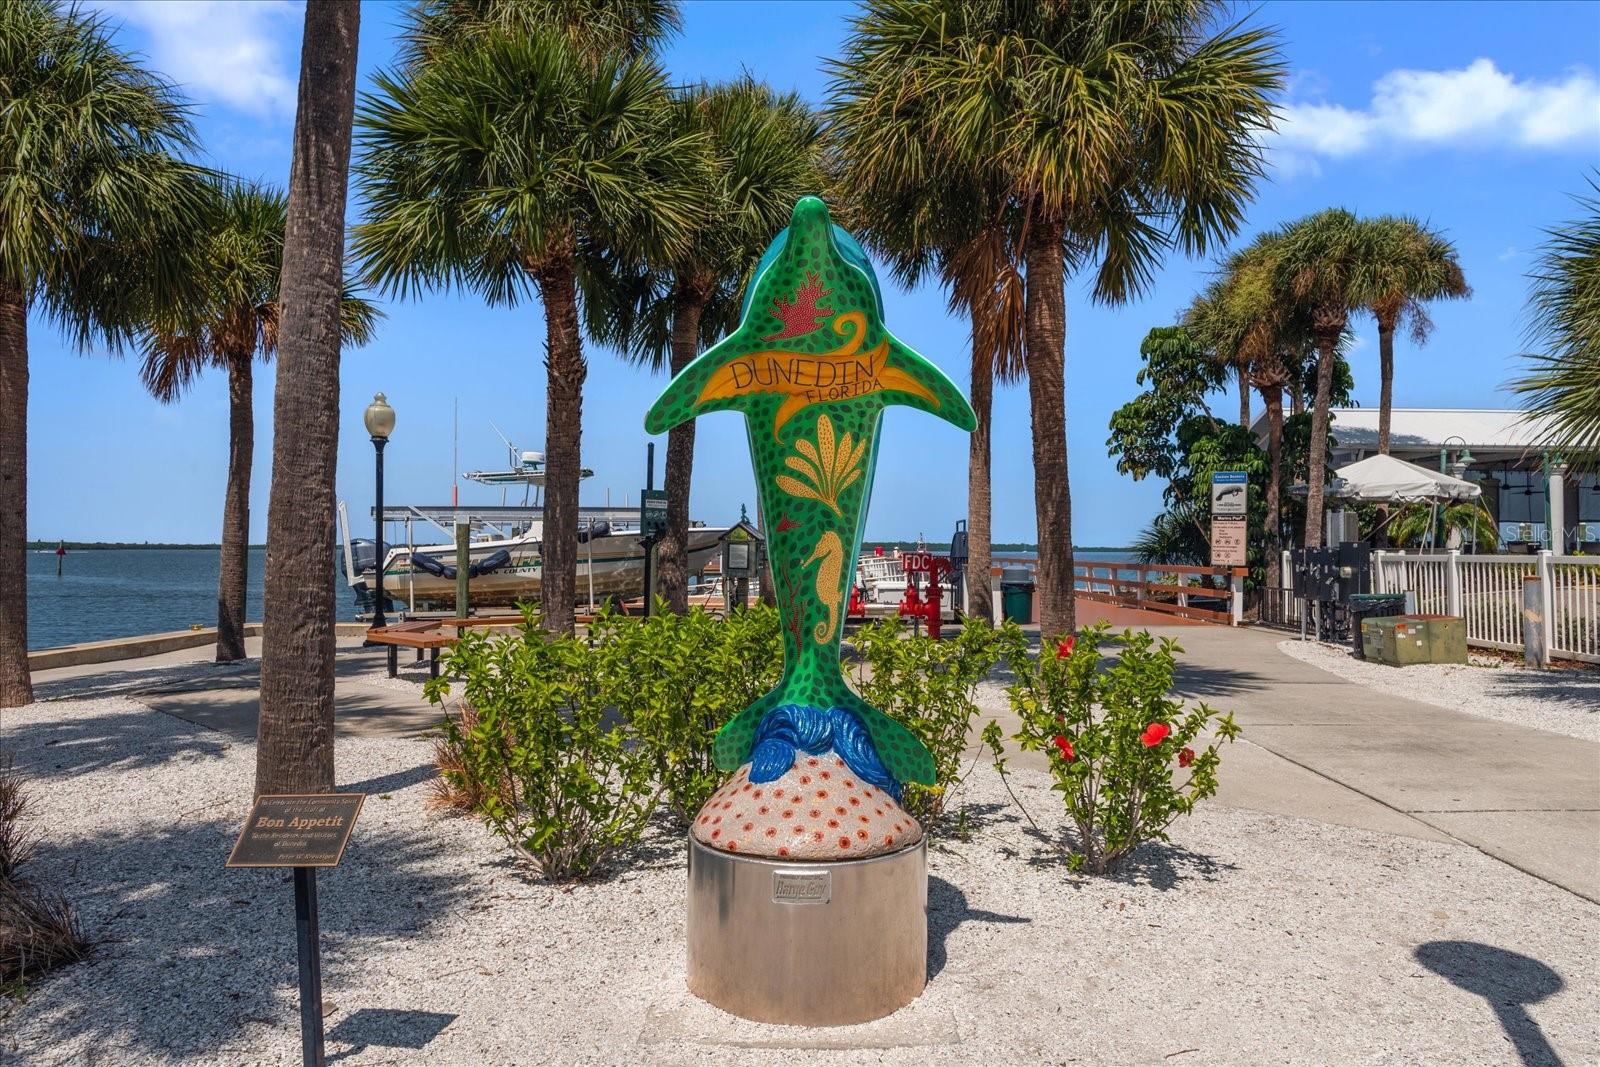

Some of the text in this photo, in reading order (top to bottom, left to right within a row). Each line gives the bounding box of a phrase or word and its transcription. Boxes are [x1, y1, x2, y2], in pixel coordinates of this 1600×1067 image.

[729, 354, 875, 390] DUNEDIN
[805, 377, 885, 403] FLORIDA
[904, 555, 930, 570] FDC
[503, 567, 538, 575] COUNTY
[256, 815, 343, 830] Bon Appetit
